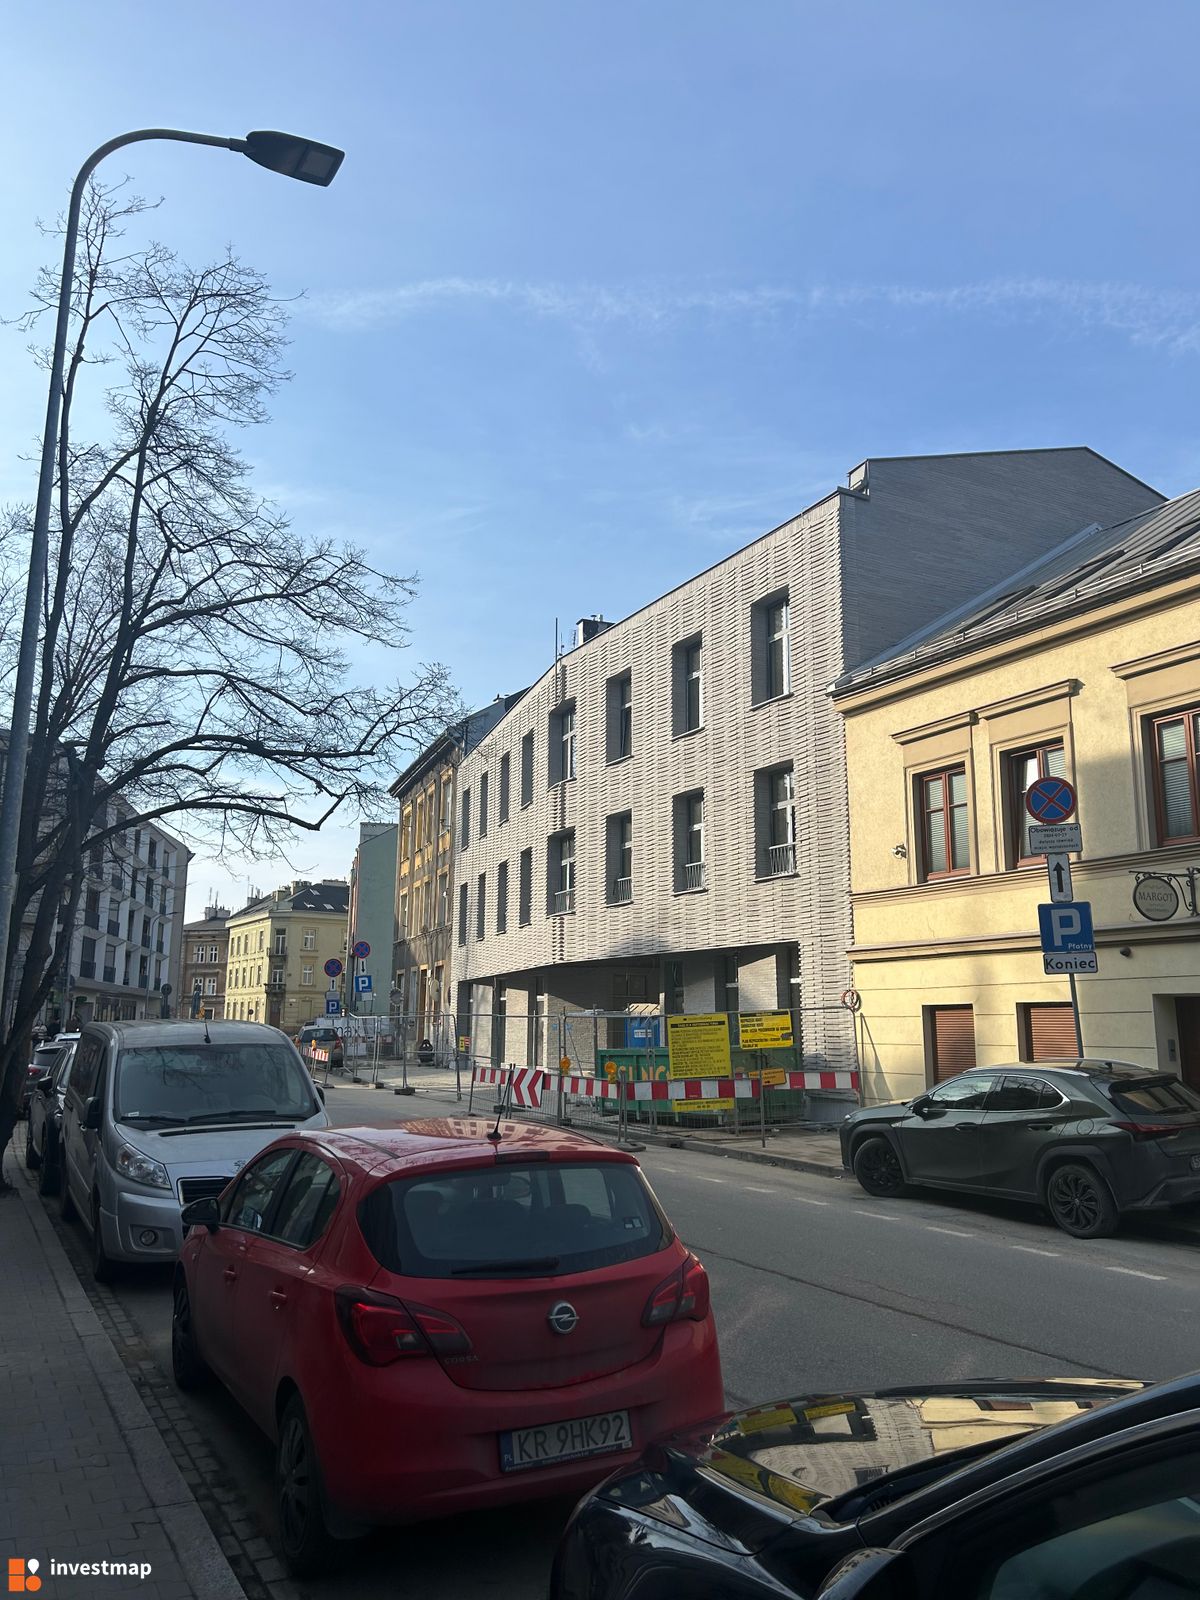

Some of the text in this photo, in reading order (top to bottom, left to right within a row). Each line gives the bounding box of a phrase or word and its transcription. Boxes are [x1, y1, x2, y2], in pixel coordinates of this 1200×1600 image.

[1138, 892, 1174, 902] MARGOT
[1050, 908, 1082, 946] P
[1045, 957, 1095, 970] Koniec
[359, 977, 369, 991] P
[329, 1001, 337, 1013] P
[518, 1413, 626, 1461] KR 9HK92
